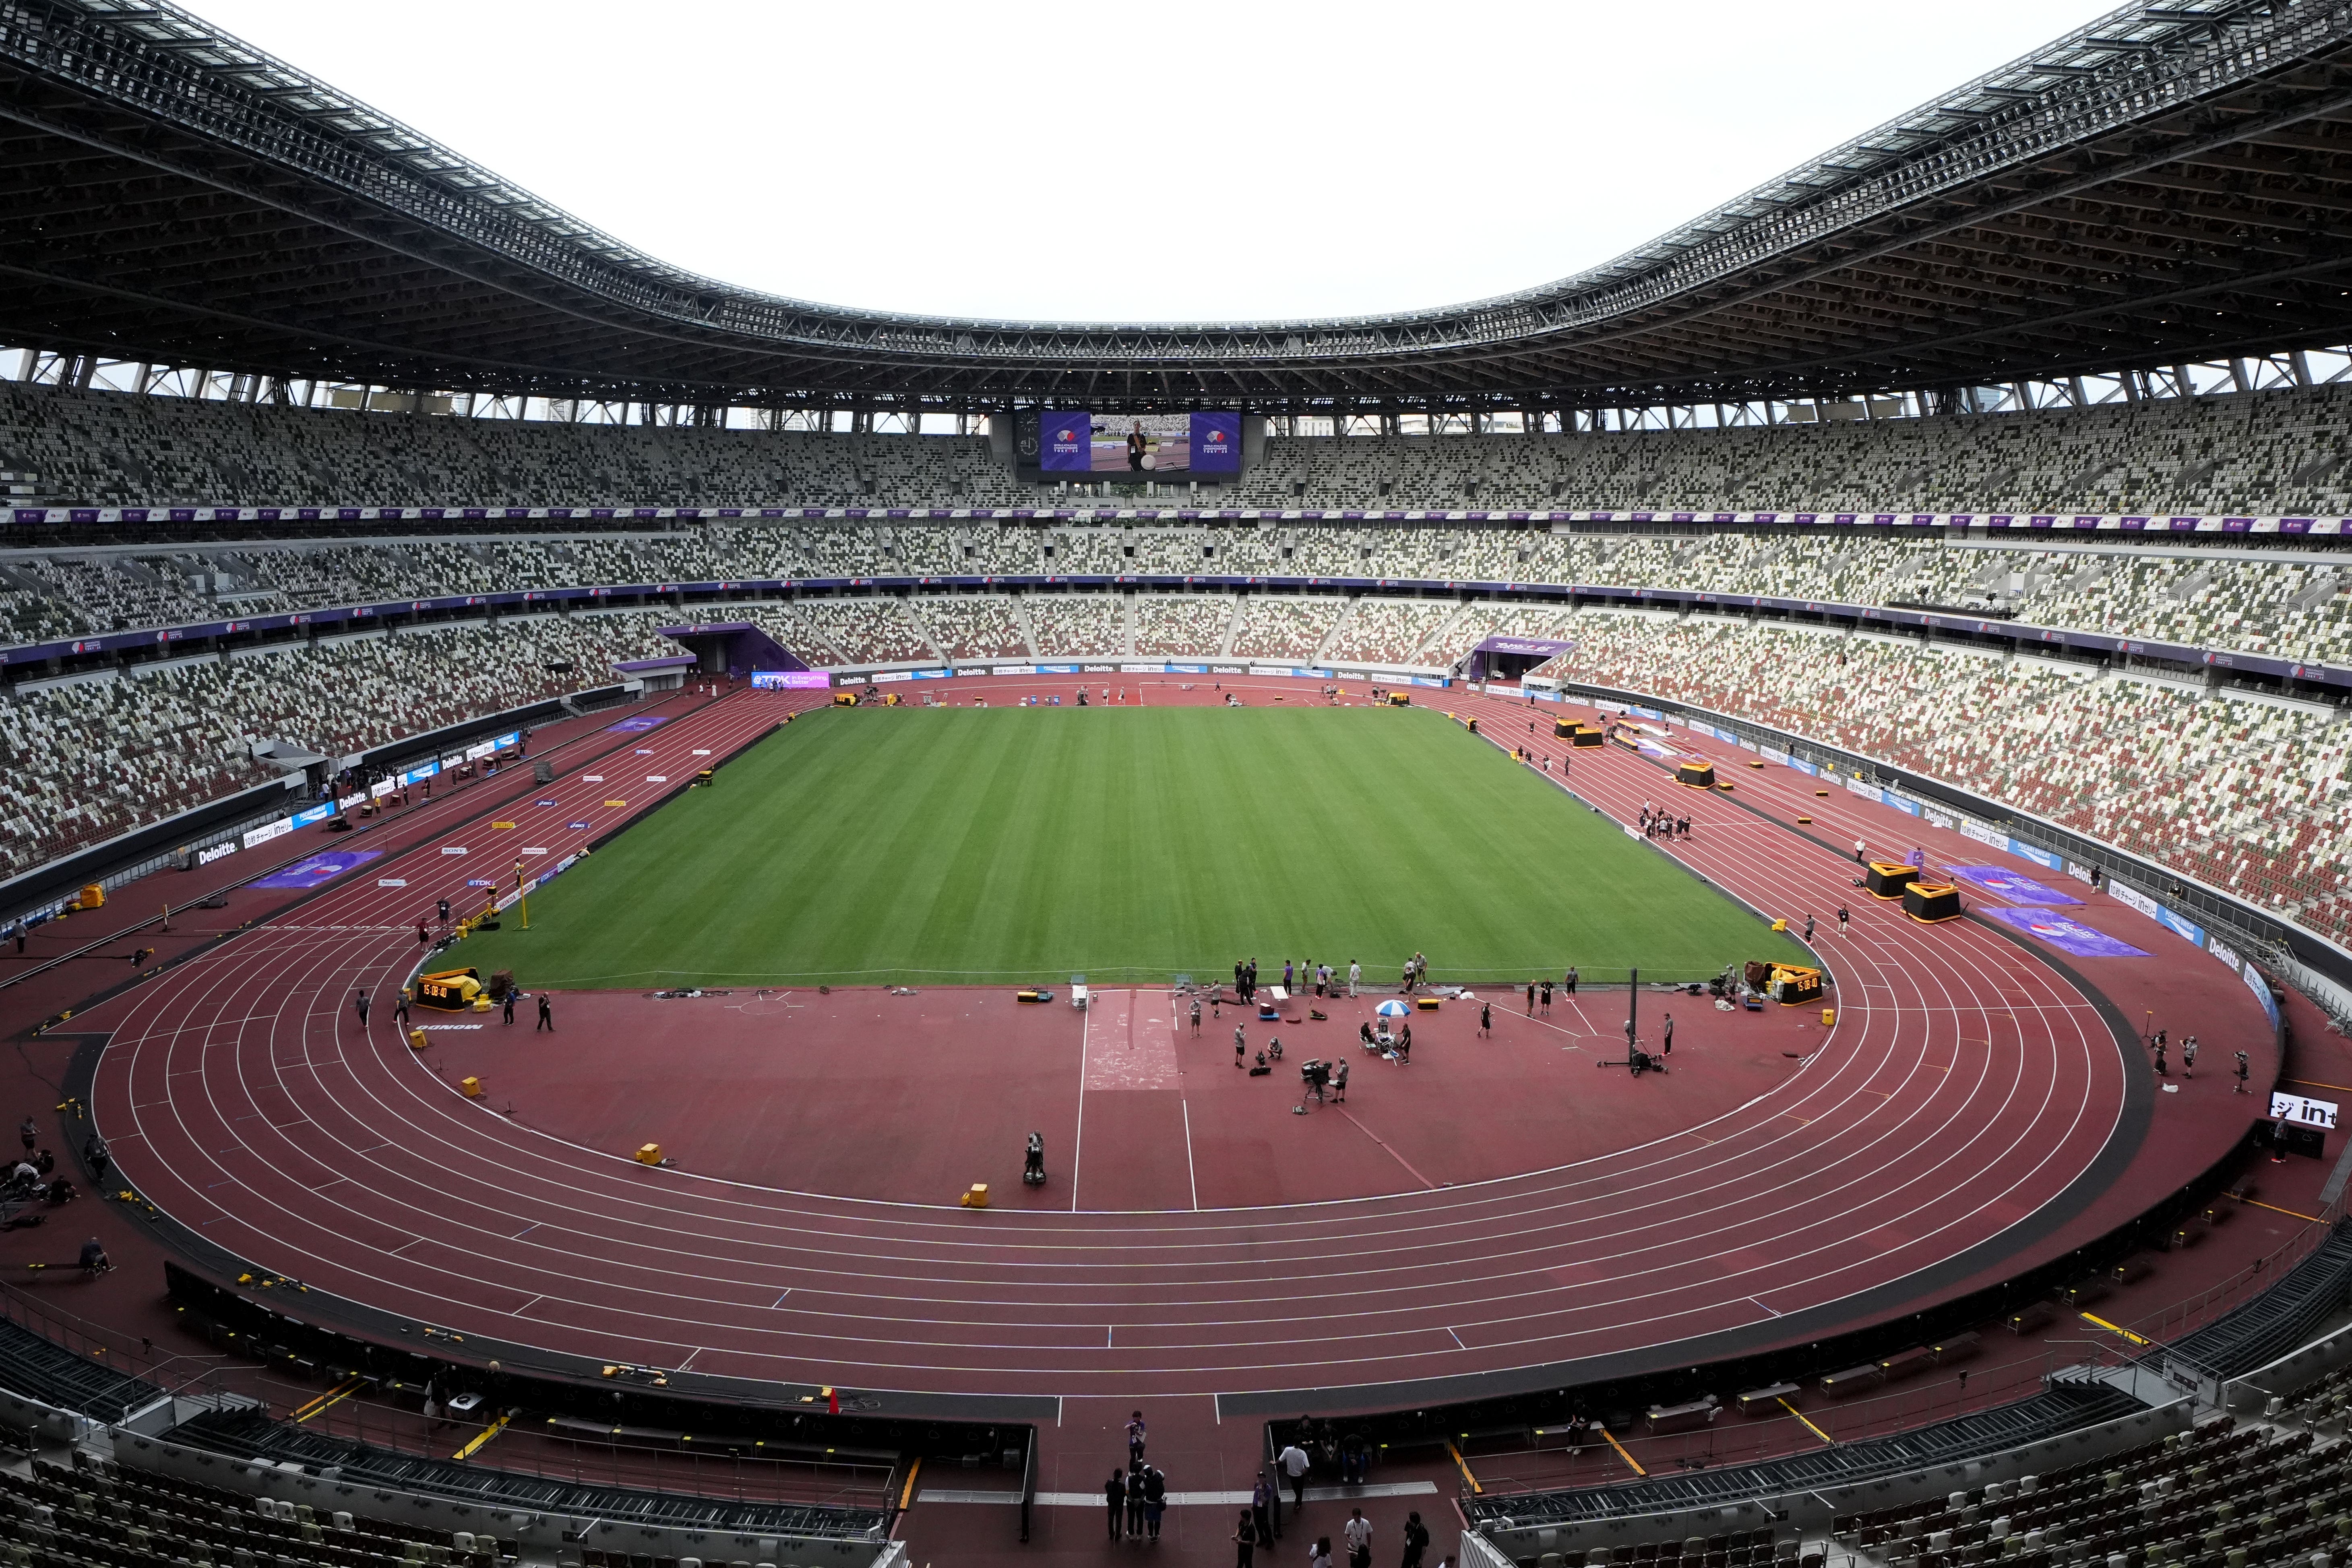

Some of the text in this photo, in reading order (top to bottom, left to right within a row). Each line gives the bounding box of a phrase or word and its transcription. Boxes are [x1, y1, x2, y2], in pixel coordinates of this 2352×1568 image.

[442, 754, 464, 770] Deloitte.
[339, 792, 368, 810] Deloitte.
[1888, 794, 1912, 807] POCARI SWEAT
[300, 805, 326, 820] POCARI SWEAT
[245, 823, 291, 846] 10秒チャージ inゼリー
[1961, 825, 2007, 847] 10秒チャージ inゼリー
[199, 842, 238, 865] Deloitte.
[2017, 843, 2050, 858] POCARI SWEAT
[518, 883, 534, 896] HNDA
[499, 895, 516, 909] HONDA
[2110, 885, 2155, 914] 10秒チャージ inゼリー
[2165, 910, 2195, 930] POCARI SWEAT
[2209, 937, 2240, 973] Deloitte.
[424, 984, 447, 998] 15:08:40
[1798, 977, 1817, 992] 15:08:40
